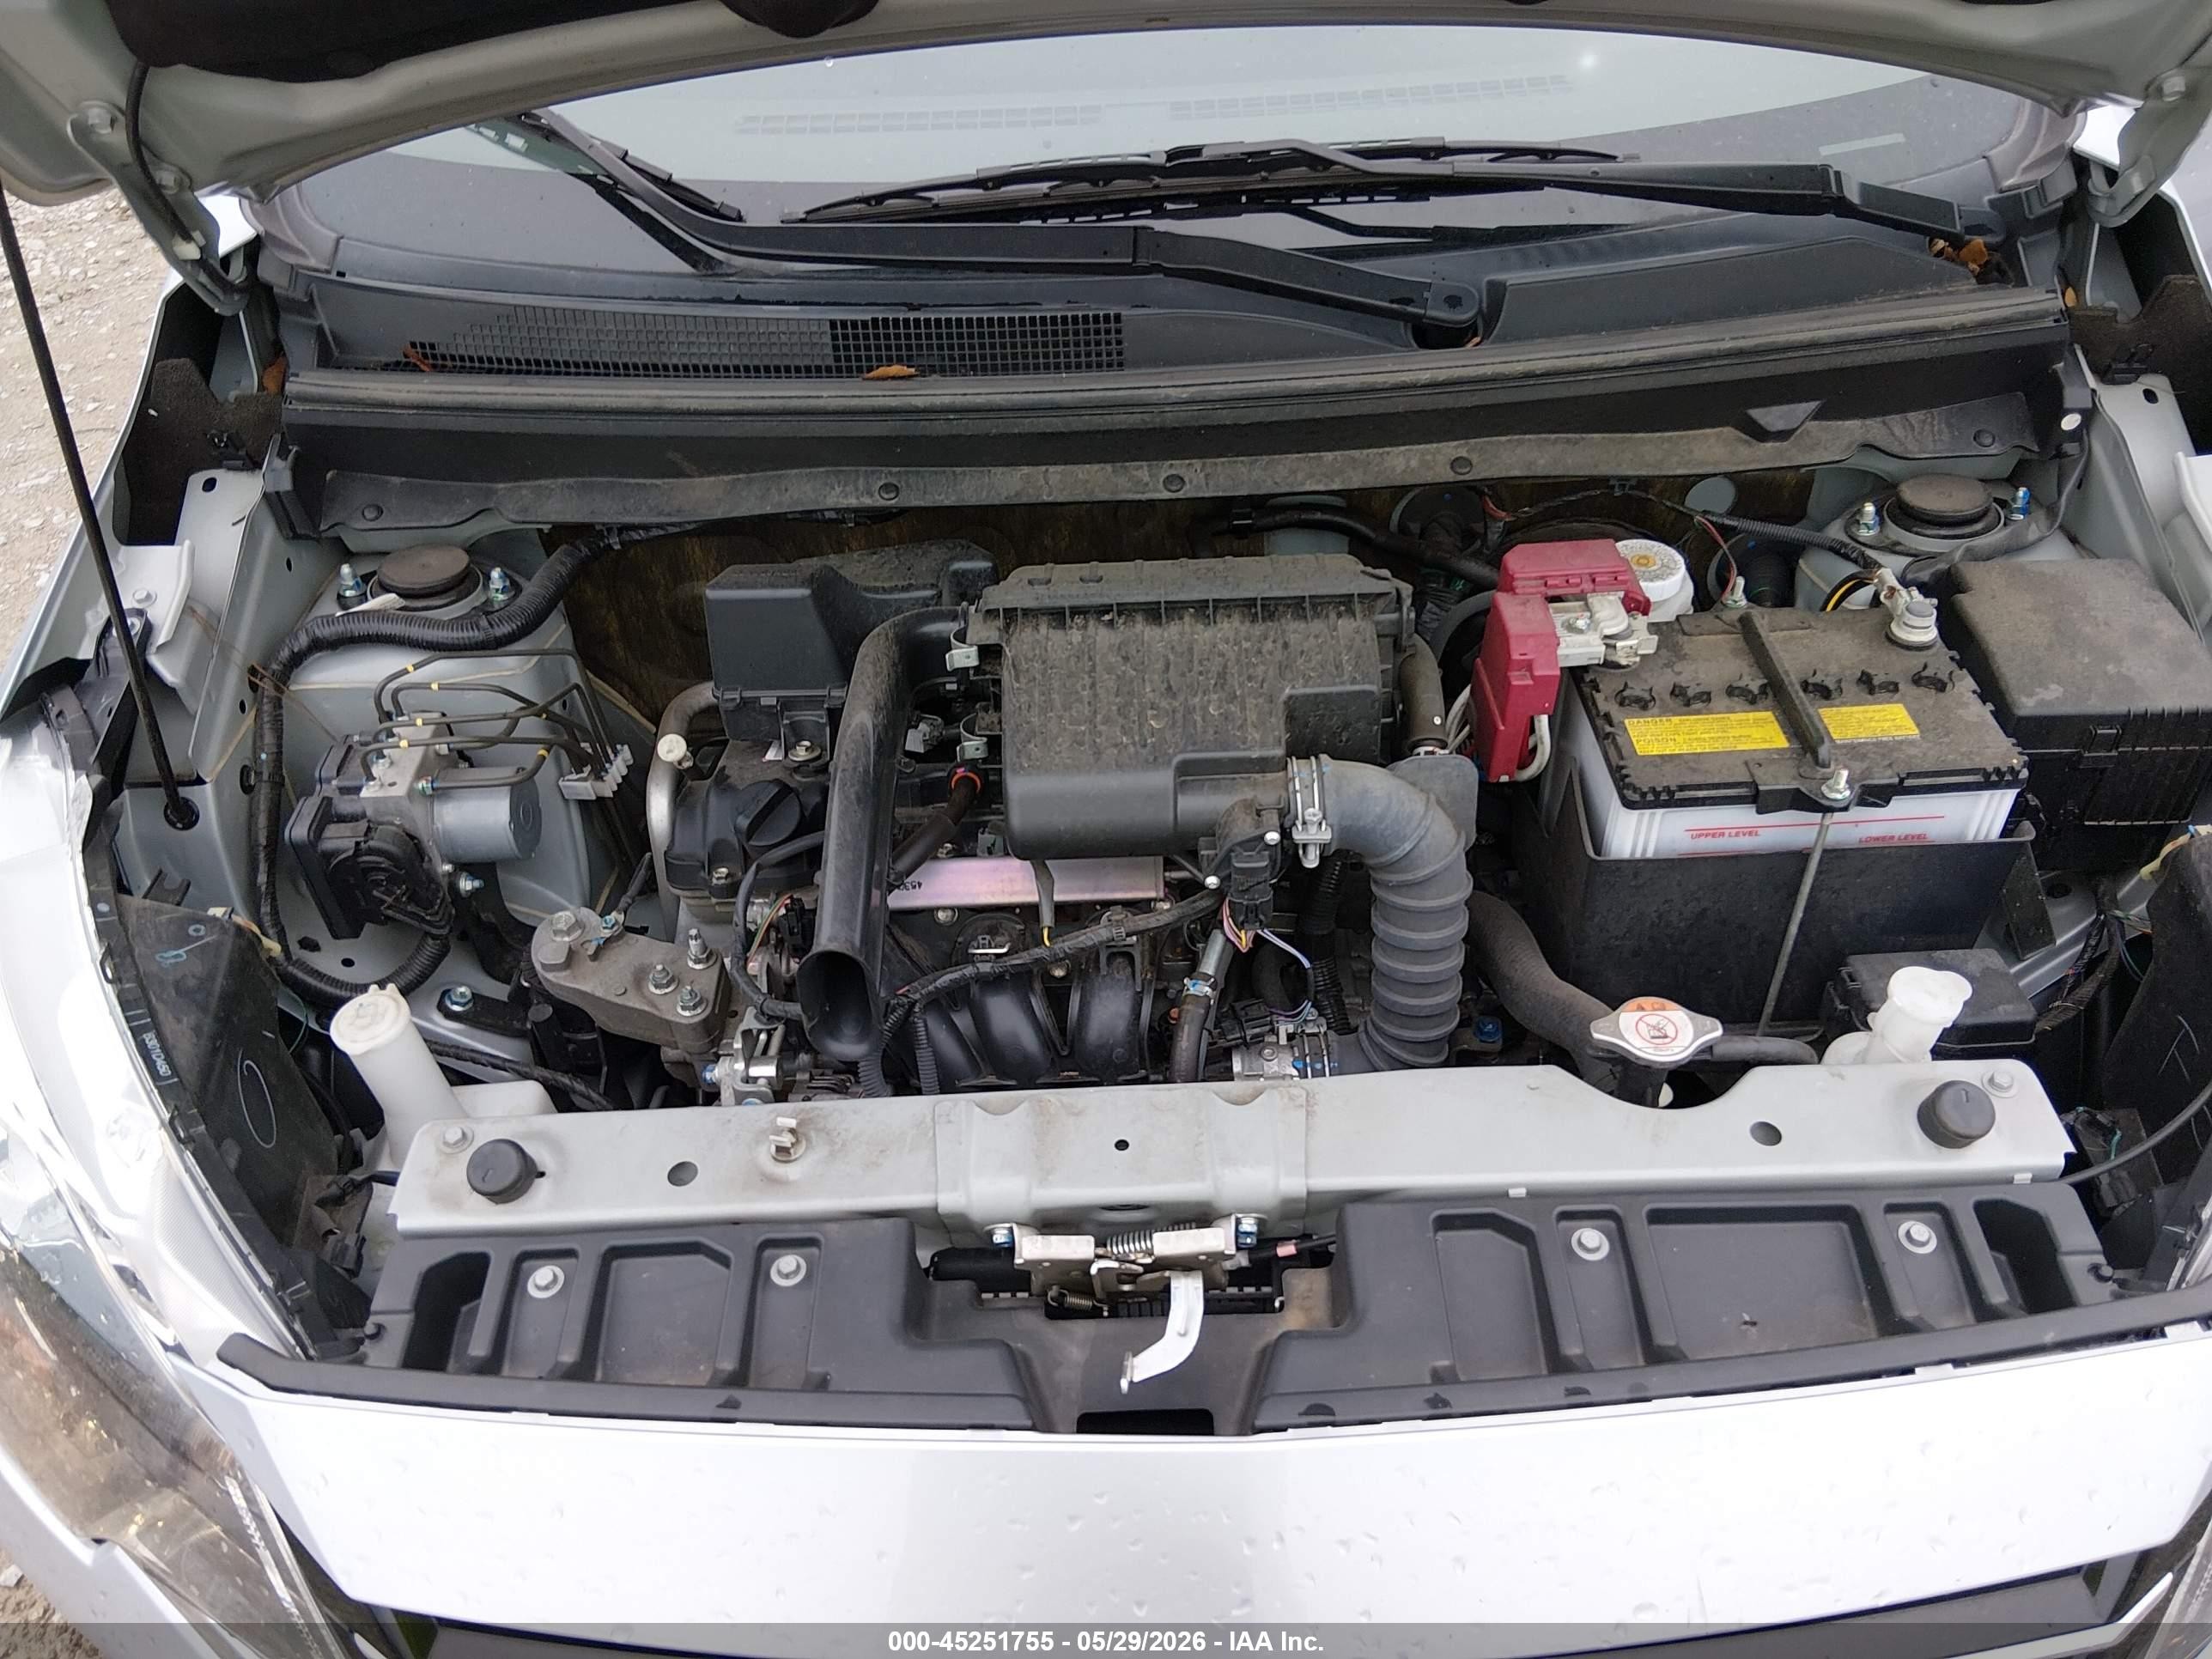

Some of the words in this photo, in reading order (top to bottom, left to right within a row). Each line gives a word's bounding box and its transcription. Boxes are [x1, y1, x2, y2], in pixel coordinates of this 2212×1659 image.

[1690, 830, 1725, 840] UPPER
[1729, 830, 1760, 838] LEVEL
[1858, 835, 1896, 843] LOWER
[1899, 833, 1928, 842] LEVEL
